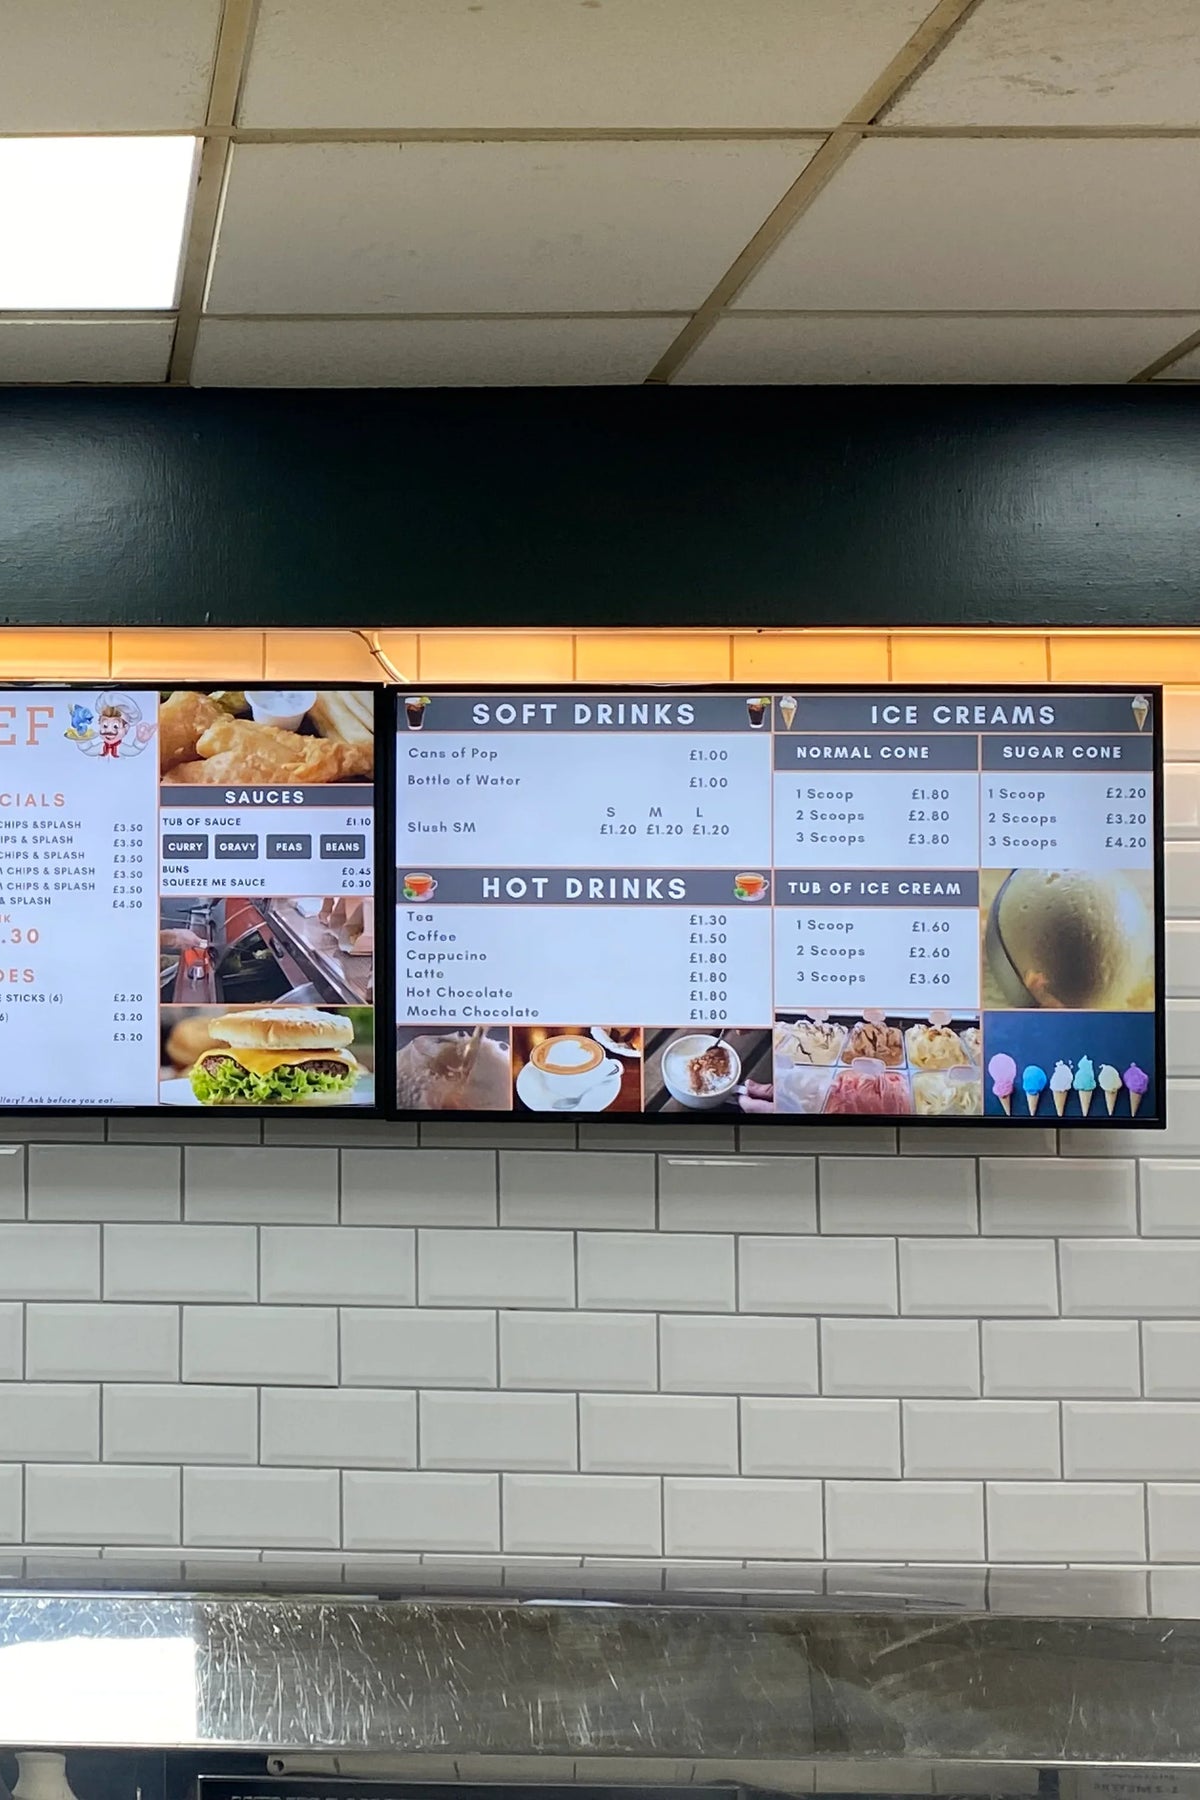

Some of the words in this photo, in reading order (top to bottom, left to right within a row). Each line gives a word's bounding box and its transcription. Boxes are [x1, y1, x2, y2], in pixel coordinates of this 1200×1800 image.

[473, 704, 557, 724] SOFT
[575, 704, 694, 724] DRINKS
[872, 706, 917, 724] ICE
[933, 706, 1054, 724] CREAMS
[409, 748, 446, 758] Cans
[452, 747, 466, 758] of
[472, 748, 497, 761] Pop
[690, 750, 728, 760] £1.00
[797, 747, 871, 758] NORMAL
[880, 747, 928, 758] CONE
[1003, 746, 1064, 758] SUGAR
[1072, 747, 1121, 758] CONE
[408, 774, 450, 785] Bottle
[456, 774, 470, 785] of
[476, 775, 520, 785] Water
[689, 777, 727, 788] £1.00
[225, 791, 304, 804] SAUCES
[607, 807, 615, 817] S
[649, 807, 662, 817] M
[696, 807, 703, 817] L
[796, 810, 804, 820] 2
[810, 810, 864, 824] Scoops
[908, 810, 949, 821] £2.80
[163, 818, 182, 826] TUB
[186, 818, 200, 826] OF
[205, 818, 240, 826] SAUCE
[346, 818, 371, 826] £1.10
[408, 821, 447, 832] Slush
[453, 822, 476, 832] SM
[114, 824, 143, 832] £3.50
[600, 824, 636, 834] £1.20
[647, 824, 683, 835] £1.20
[693, 824, 729, 835] £1.20
[168, 843, 203, 851] CURRY
[220, 843, 256, 851] GRAVY
[276, 843, 302, 851] PEAS
[326, 843, 359, 851] BEANS
[989, 836, 996, 846] 3
[1002, 836, 1057, 850] Scoops
[1105, 836, 1146, 848] £4.20
[342, 880, 371, 888] £0.30
[483, 878, 548, 898] HOT
[566, 878, 685, 899] DRINKS
[788, 882, 821, 894] TUB
[829, 882, 851, 894] OF
[861, 883, 889, 894] ICE
[898, 883, 960, 894] CREAM
[407, 930, 456, 941] Coffee
[690, 933, 726, 944] £1.50
[407, 950, 486, 964] Cappucino
[689, 952, 727, 963] £1.80
[797, 945, 804, 956] 2
[810, 945, 865, 959] Scoops
[909, 947, 950, 958] £2.60
[407, 968, 444, 978] Latte
[690, 971, 727, 982] £1.80
[407, 987, 430, 997] Hot
[436, 986, 512, 998] Chocolate
[690, 990, 727, 1001] £1.80
[6, 994, 45, 1002] STICKS
[49, 994, 63, 1004] (6)
[114, 994, 142, 1002] £2.20
[79, 1096, 95, 1105] you
